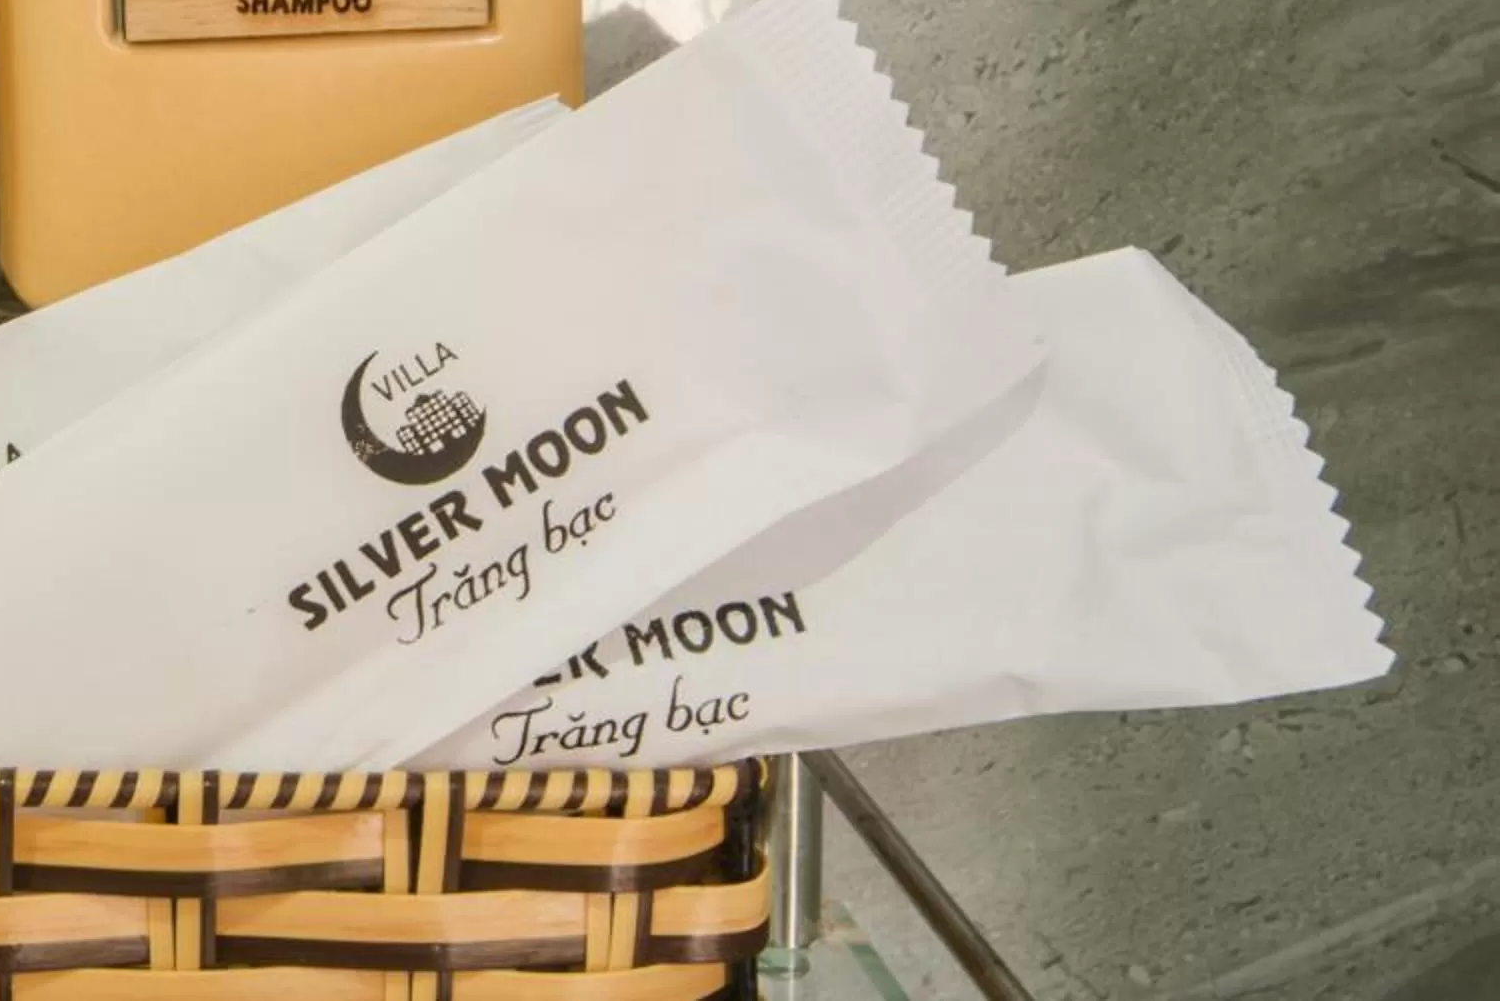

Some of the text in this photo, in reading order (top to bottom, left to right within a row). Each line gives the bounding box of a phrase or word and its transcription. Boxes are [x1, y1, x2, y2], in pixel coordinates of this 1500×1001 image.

[371, 341, 459, 402] VILLA
[287, 379, 650, 631] SILVER MOON
[386, 492, 617, 645] Trăng bạc
[622, 590, 806, 666] MOON
[491, 674, 750, 765] Trăng bạc
